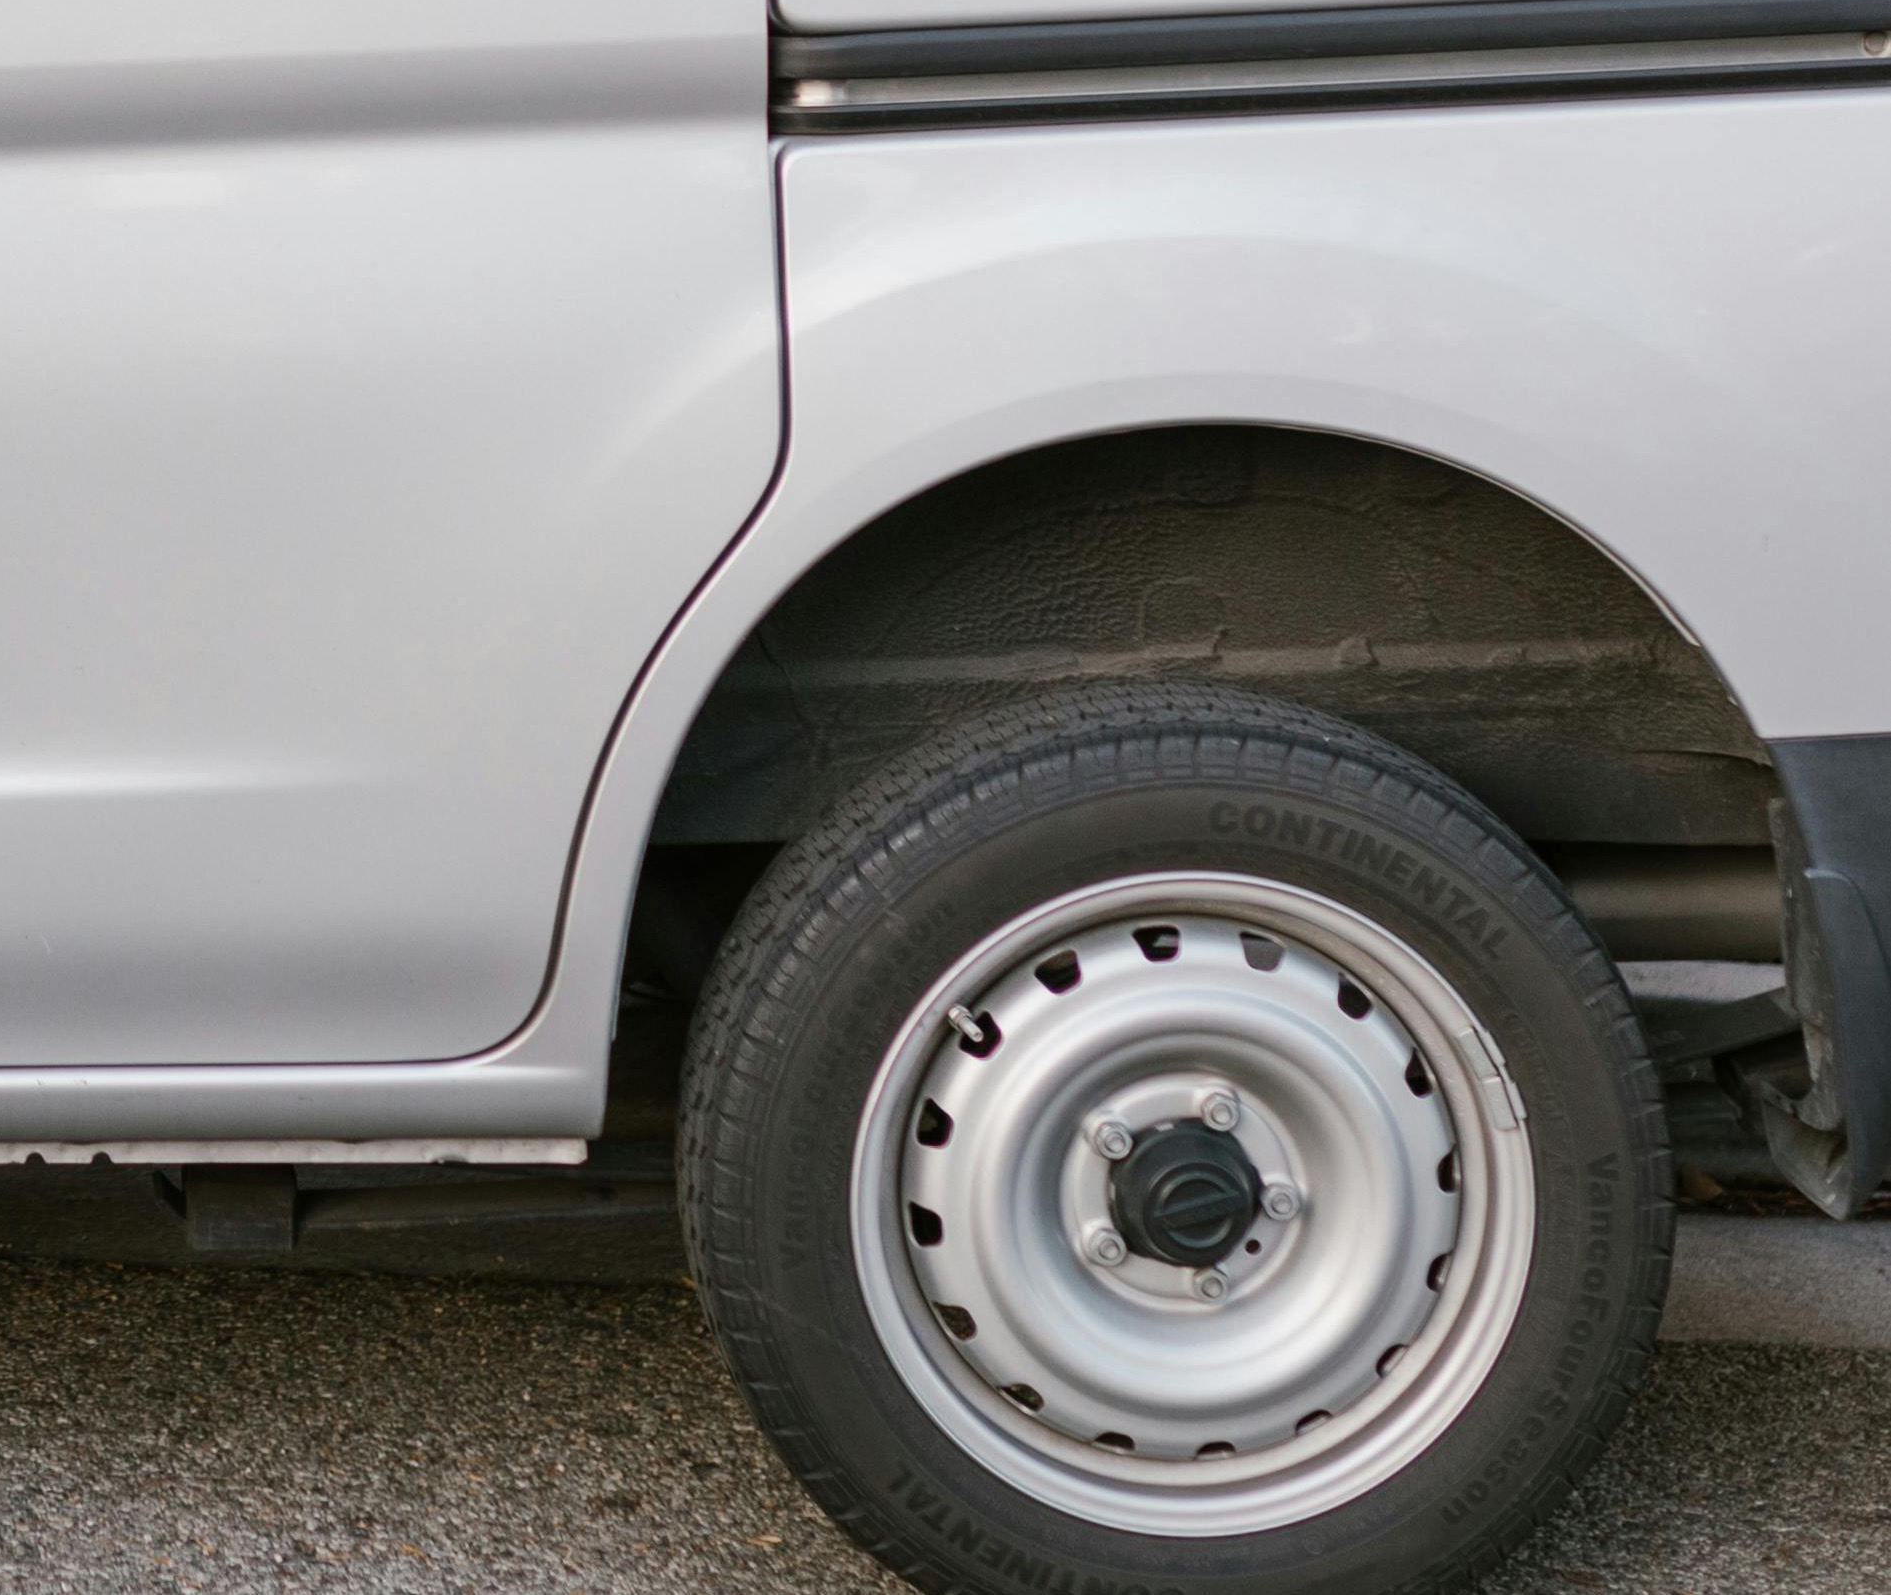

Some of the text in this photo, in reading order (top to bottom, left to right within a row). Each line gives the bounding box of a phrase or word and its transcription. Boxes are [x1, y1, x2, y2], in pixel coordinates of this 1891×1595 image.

[1206, 799, 1520, 963] CONTINENTAL
[1436, 1149, 1621, 1533] VancoFourSeason
[876, 1458, 1185, 1595] NTINENTAL
